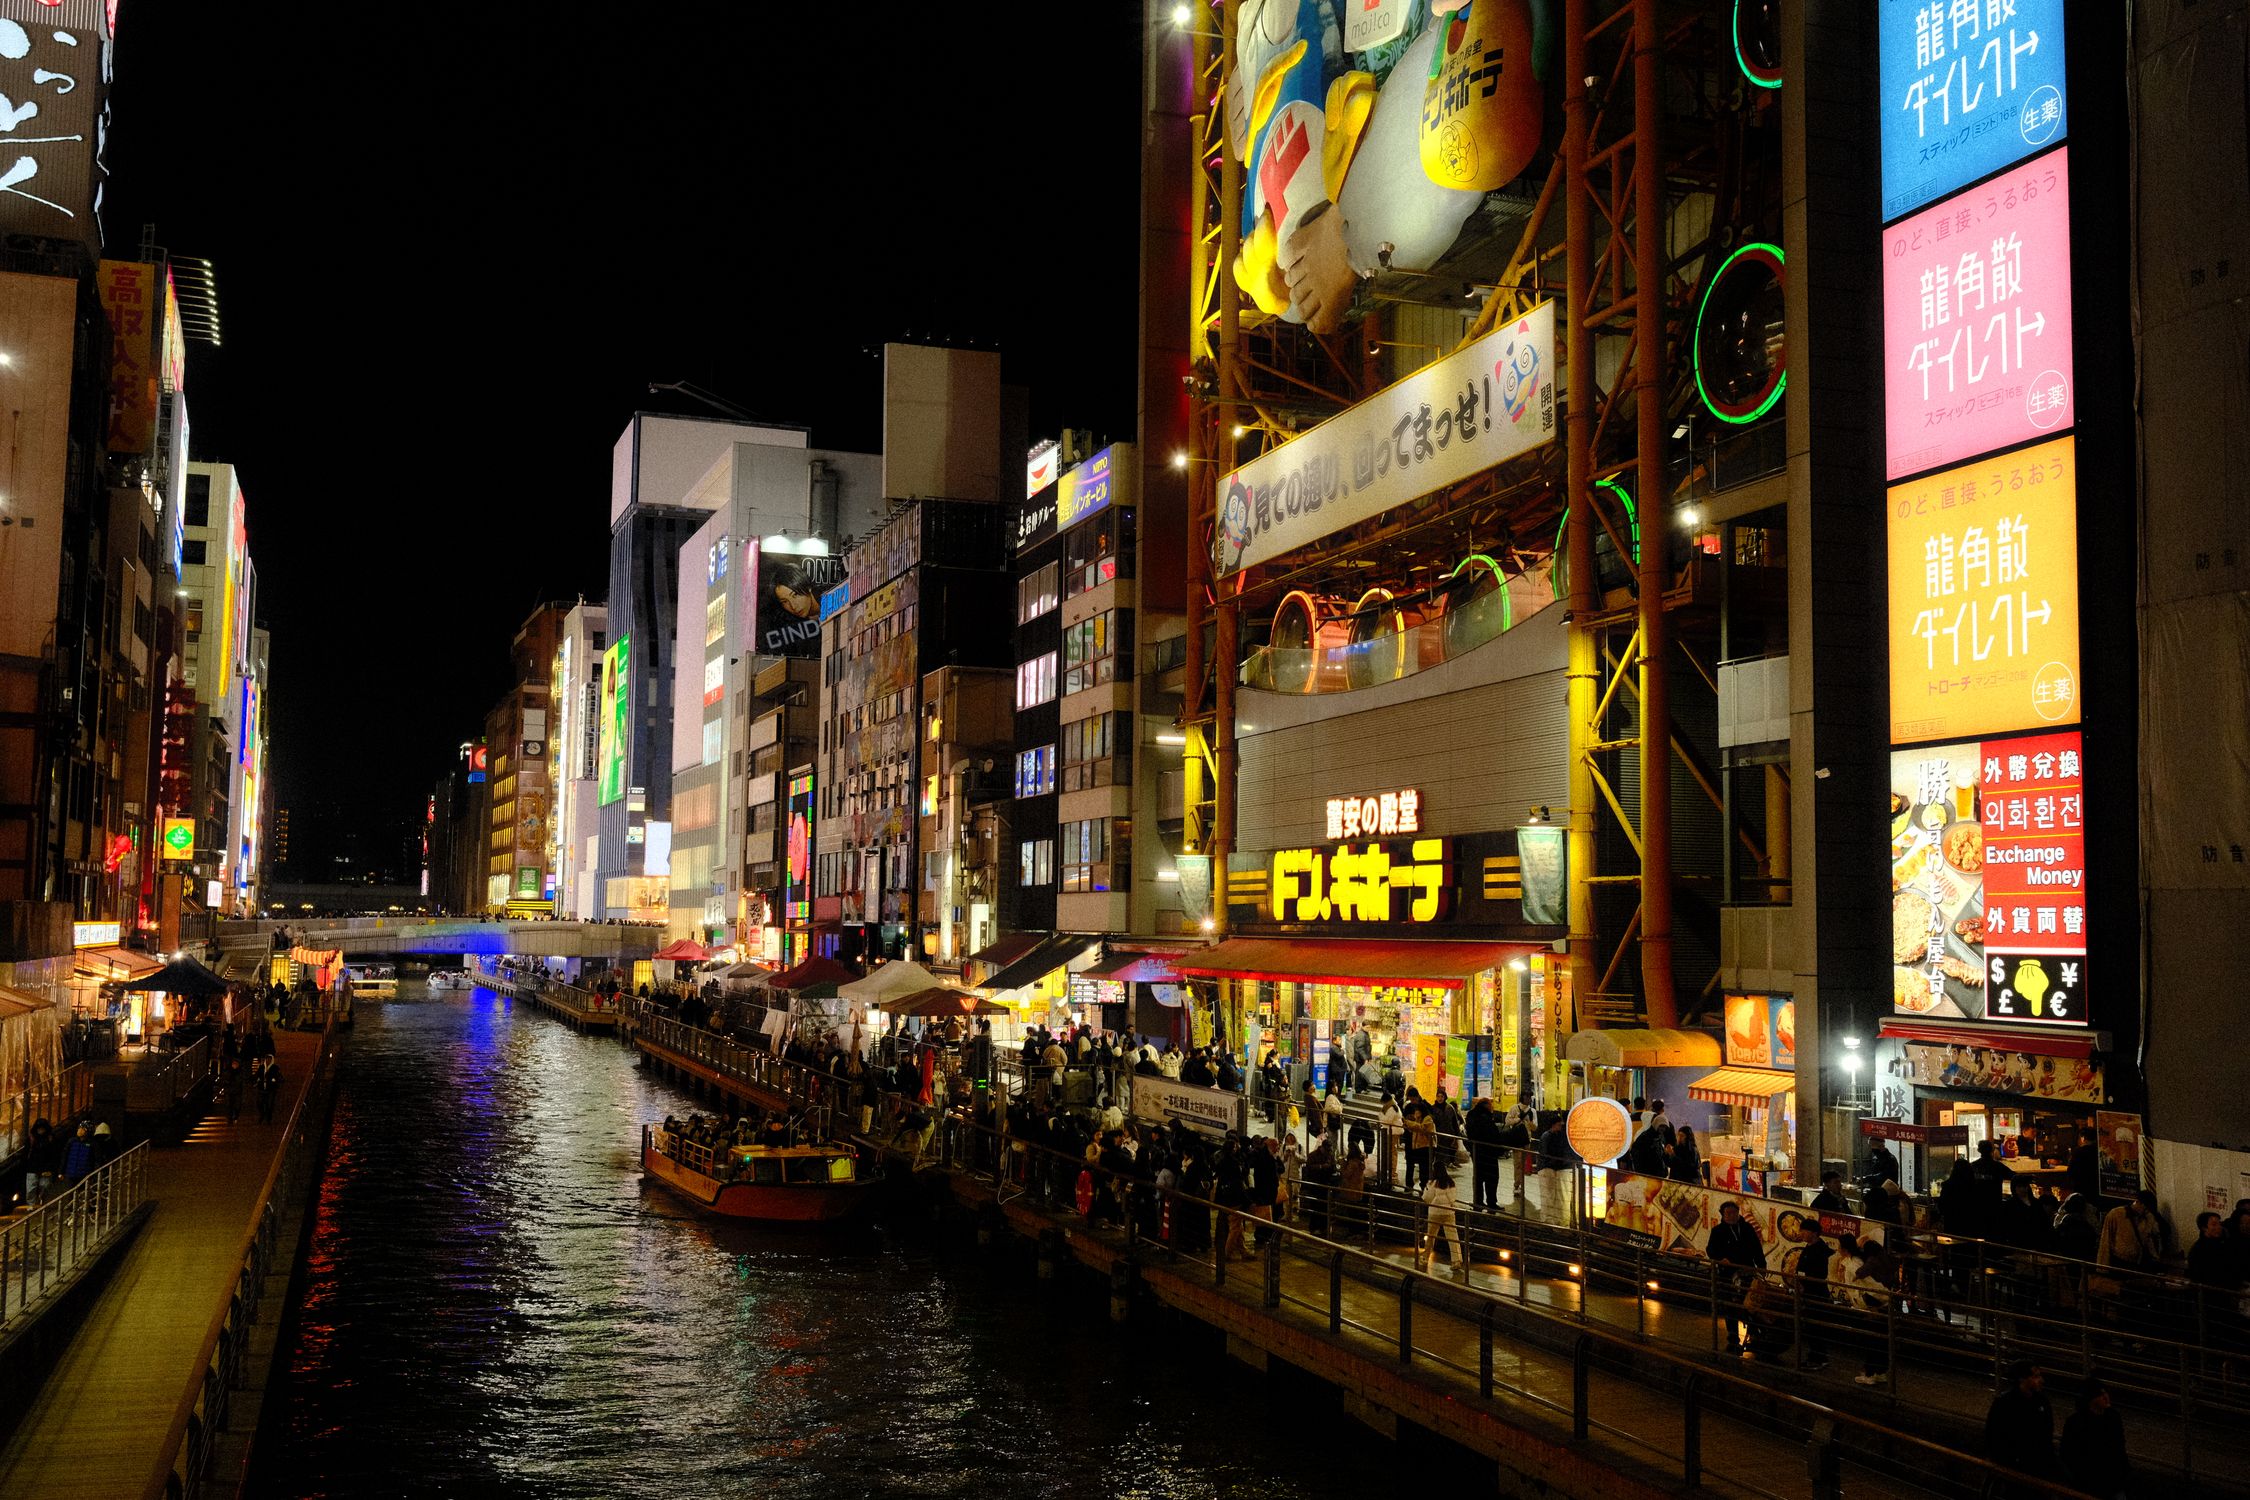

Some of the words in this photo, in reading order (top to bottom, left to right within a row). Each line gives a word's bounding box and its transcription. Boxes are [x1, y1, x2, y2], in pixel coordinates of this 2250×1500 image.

[1914, 0, 2018, 70] 龍角散
[1902, 31, 2040, 138] ダイレクト
[2023, 97, 2060, 131] 生薬
[1919, 126, 1970, 165] スティック
[1974, 118, 1998, 135] ミント
[1920, 231, 2024, 332] 龍角散
[1907, 310, 2046, 401] ダイレクト
[1924, 398, 1976, 428] スティック
[2030, 384, 2065, 415] 生薬
[1924, 513, 2029, 598] 龍角散
[1911, 591, 2052, 670] ダイレクト
[1928, 676, 1971, 696] トローチ
[2035, 677, 2072, 704] 生薬
[1917, 758, 1950, 805] 勝
[1326, 789, 1419, 839] 驚安の殿堂
[1985, 793, 2081, 832] 외화환전
[1985, 845, 2065, 866] Exchange
[2026, 866, 2083, 888] Money
[1987, 906, 2084, 935] 外貨両替
[1882, 1084, 1911, 1118] 勝
